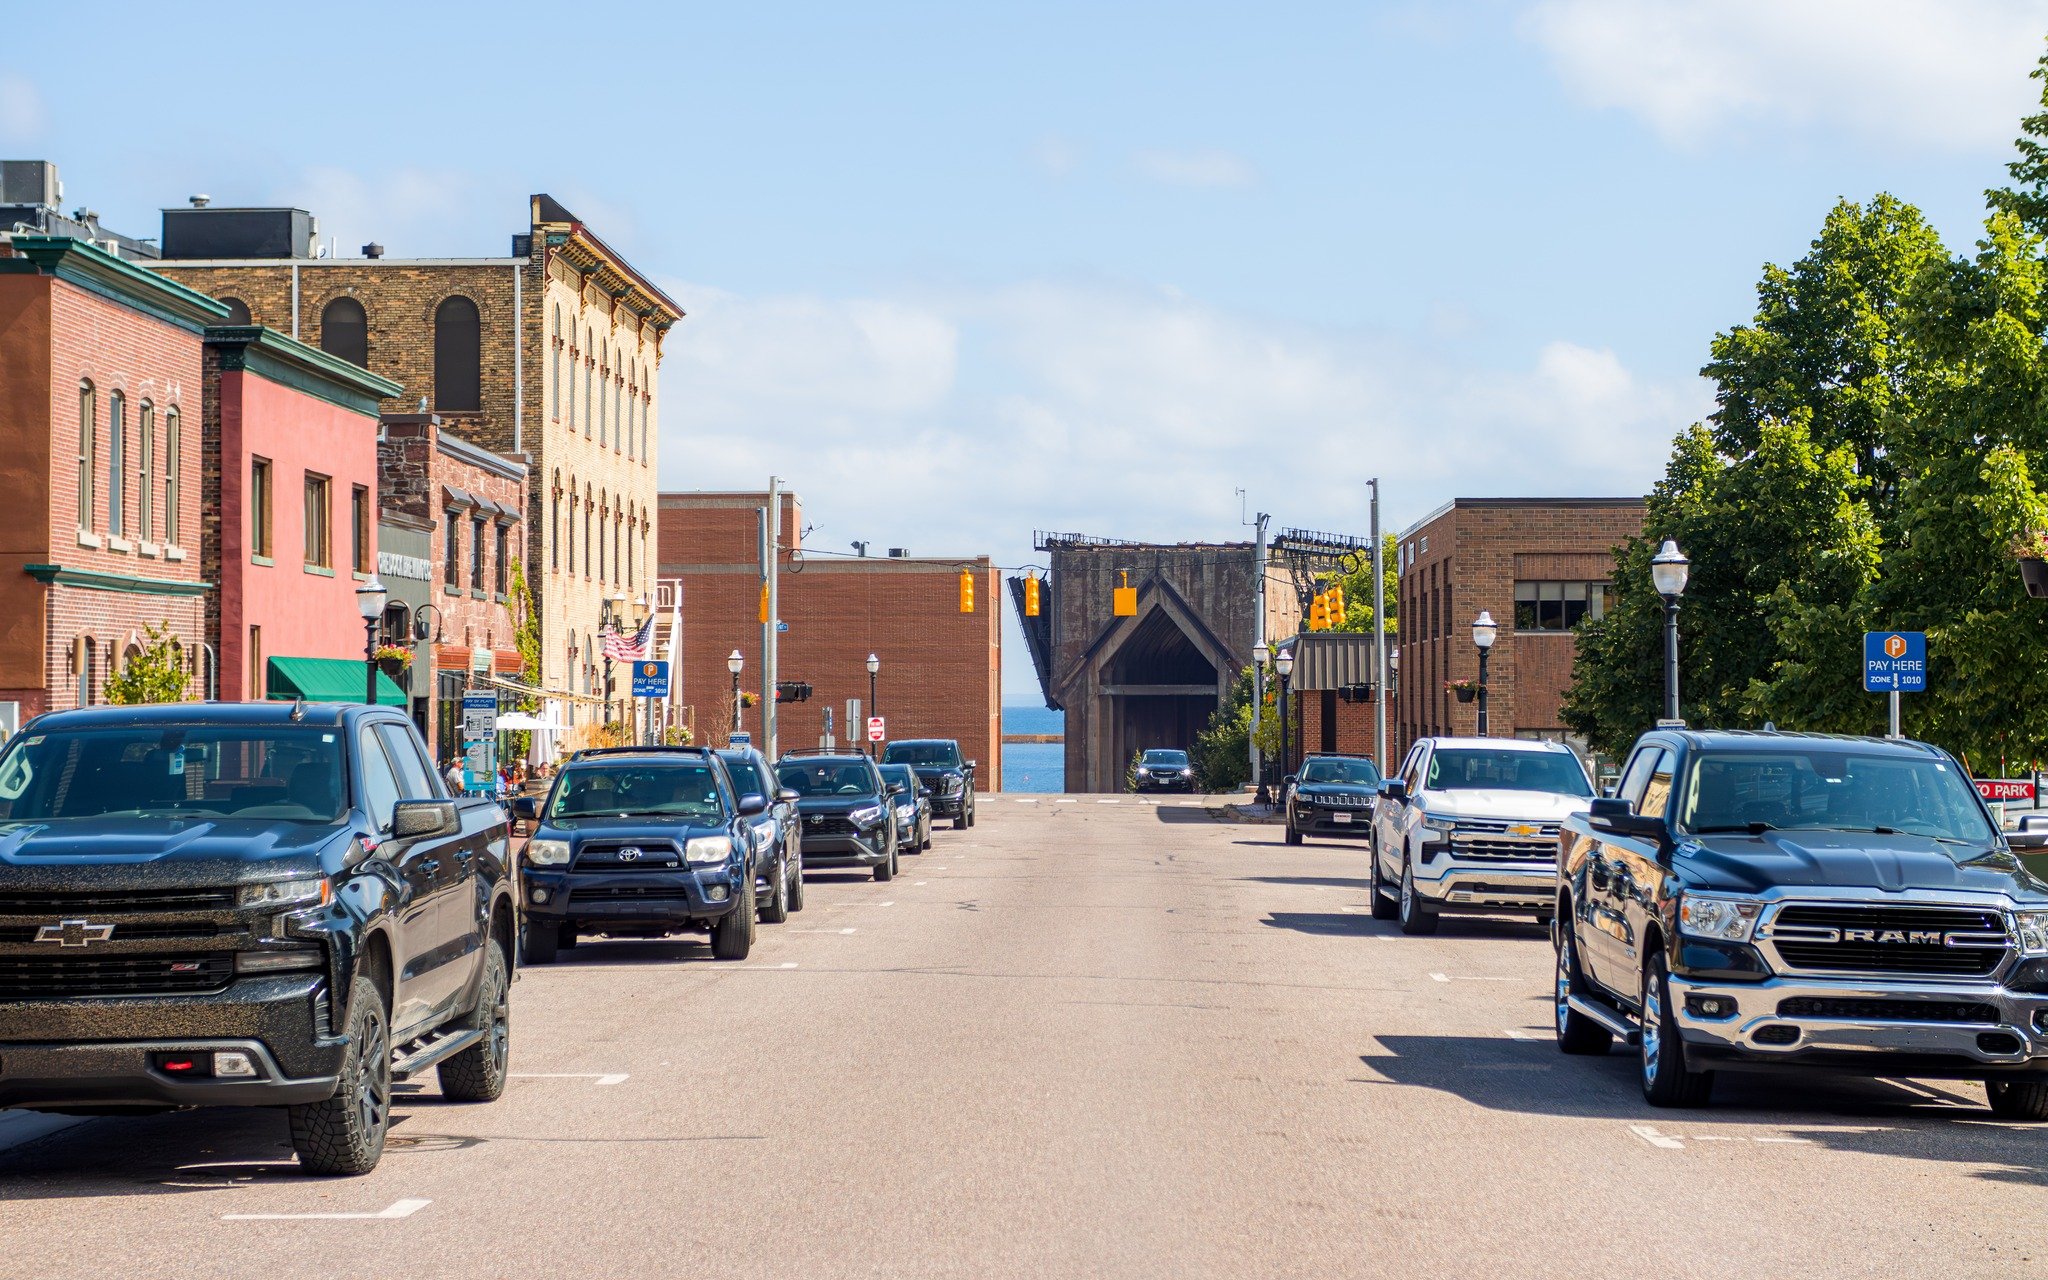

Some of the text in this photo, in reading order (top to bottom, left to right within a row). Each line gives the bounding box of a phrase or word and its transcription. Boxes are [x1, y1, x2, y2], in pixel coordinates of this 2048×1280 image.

[1868, 660, 1923, 671] PAY HERE
[1902, 676, 1921, 684] 1010
[1995, 784, 2029, 797] PARK
[1844, 928, 1941, 945] RAM
